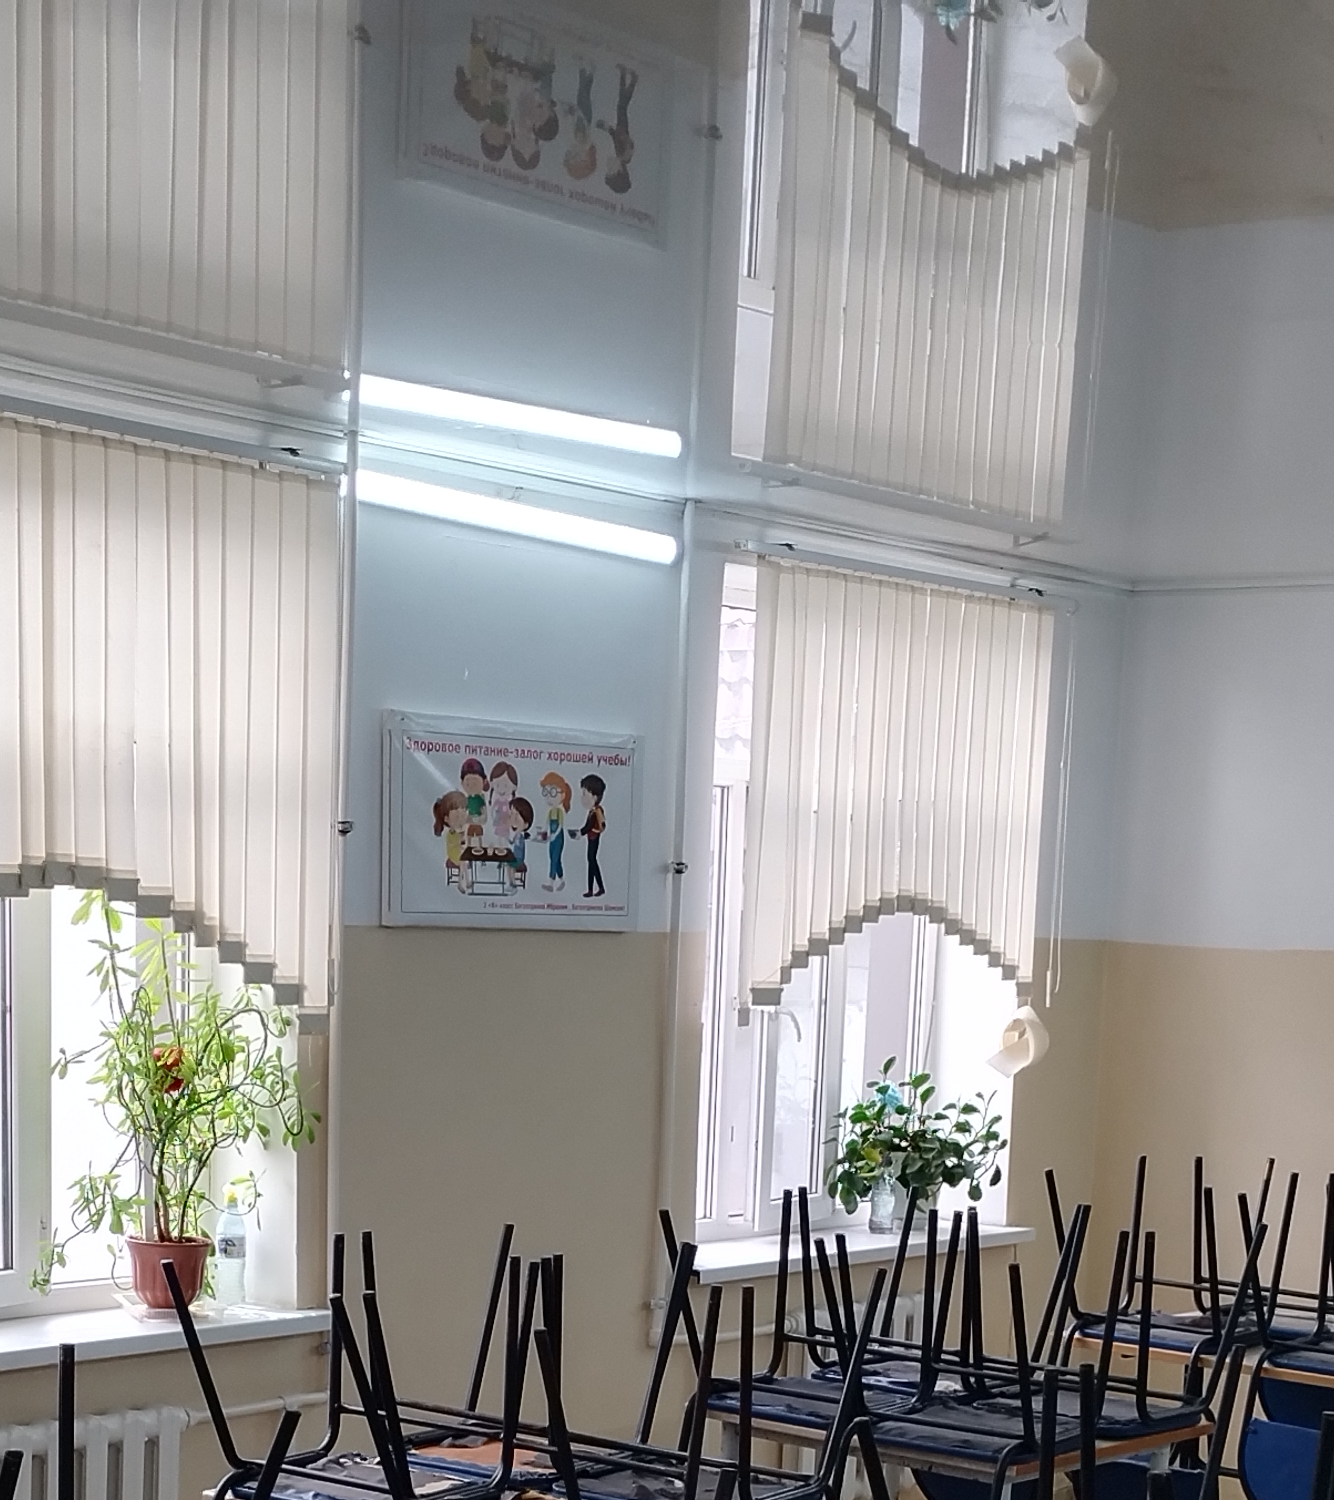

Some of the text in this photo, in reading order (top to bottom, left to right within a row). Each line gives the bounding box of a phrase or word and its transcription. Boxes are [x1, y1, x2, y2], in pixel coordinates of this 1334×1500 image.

[464, 744, 544, 760] питание-залог
[547, 751, 594, 764] хорошей
[597, 753, 631, 768] учебы!
